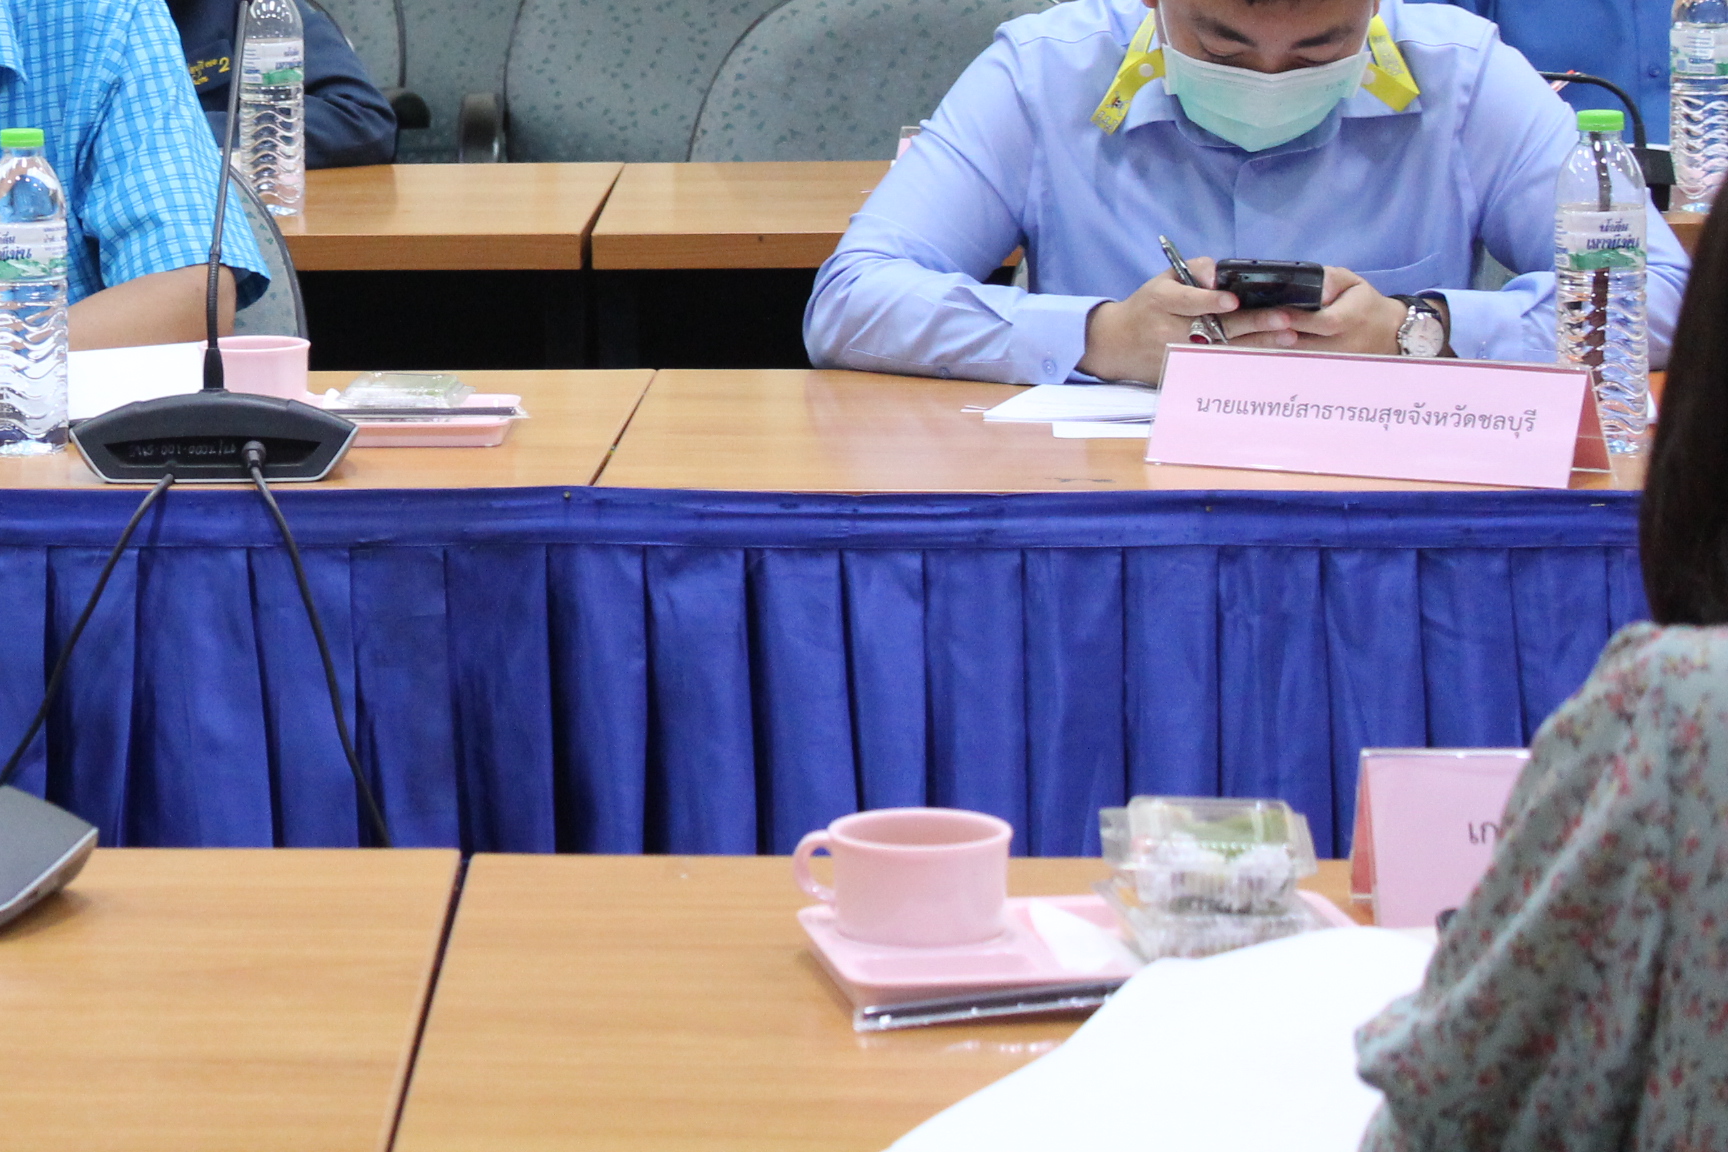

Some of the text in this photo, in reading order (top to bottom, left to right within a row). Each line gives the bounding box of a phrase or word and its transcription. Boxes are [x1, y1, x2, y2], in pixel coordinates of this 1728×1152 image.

[218, 56, 231, 73] 2
[1196, 393, 1537, 439] นายแพทย์สาธารณสุขจังหวัดชลบุรี
